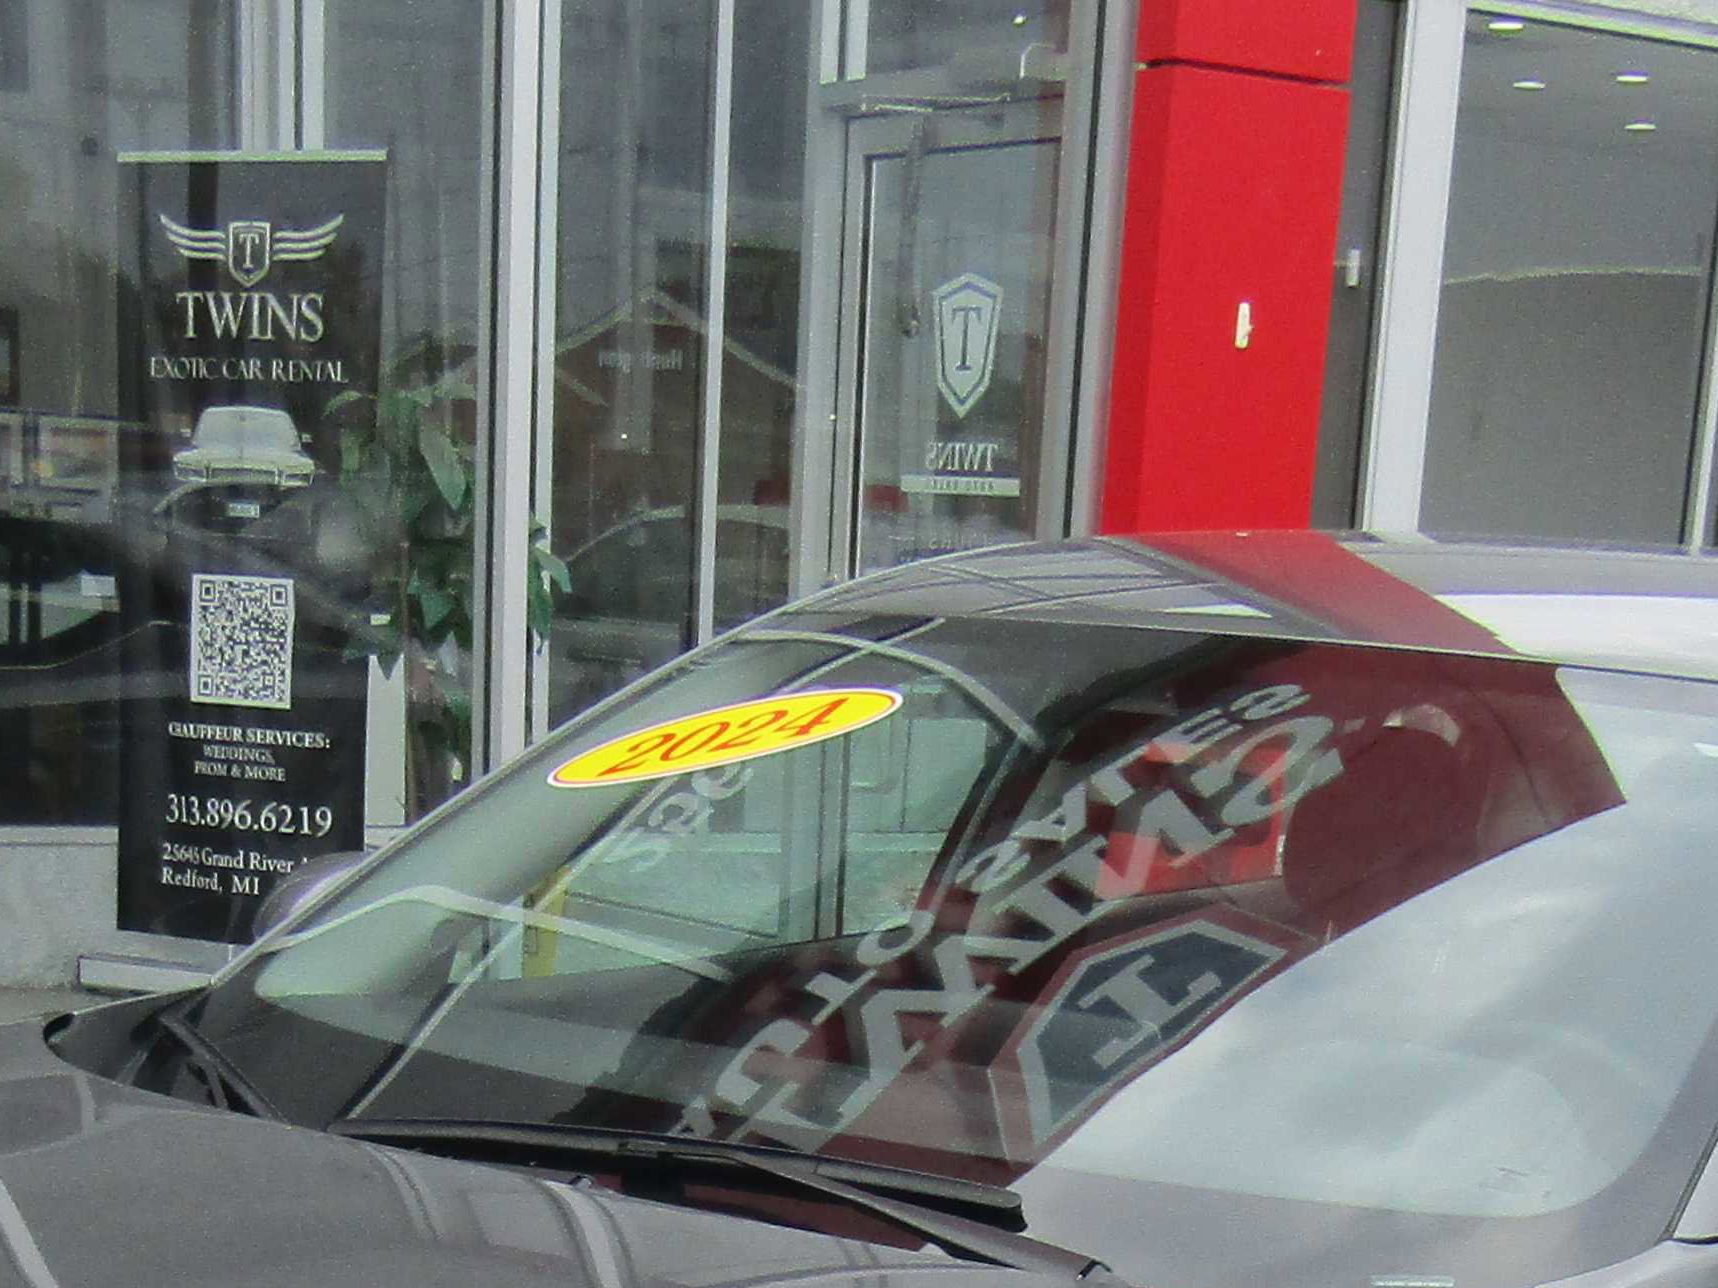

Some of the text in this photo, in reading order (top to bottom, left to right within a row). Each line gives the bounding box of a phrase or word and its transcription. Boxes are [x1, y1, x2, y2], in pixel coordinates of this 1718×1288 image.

[238, 232, 260, 269] T
[175, 290, 324, 343] TWINS
[149, 356, 349, 384] EXOTIC CAR RENTAL
[245, 727, 331, 749] SERVICES:
[595, 697, 850, 778] 2024
[230, 764, 242, 779] &
[244, 765, 286, 782] MORE
[164, 793, 333, 839] 313.896.6219
[201, 846, 245, 870] Grand
[248, 851, 294, 873] River
[161, 865, 260, 896] Redford, MI
